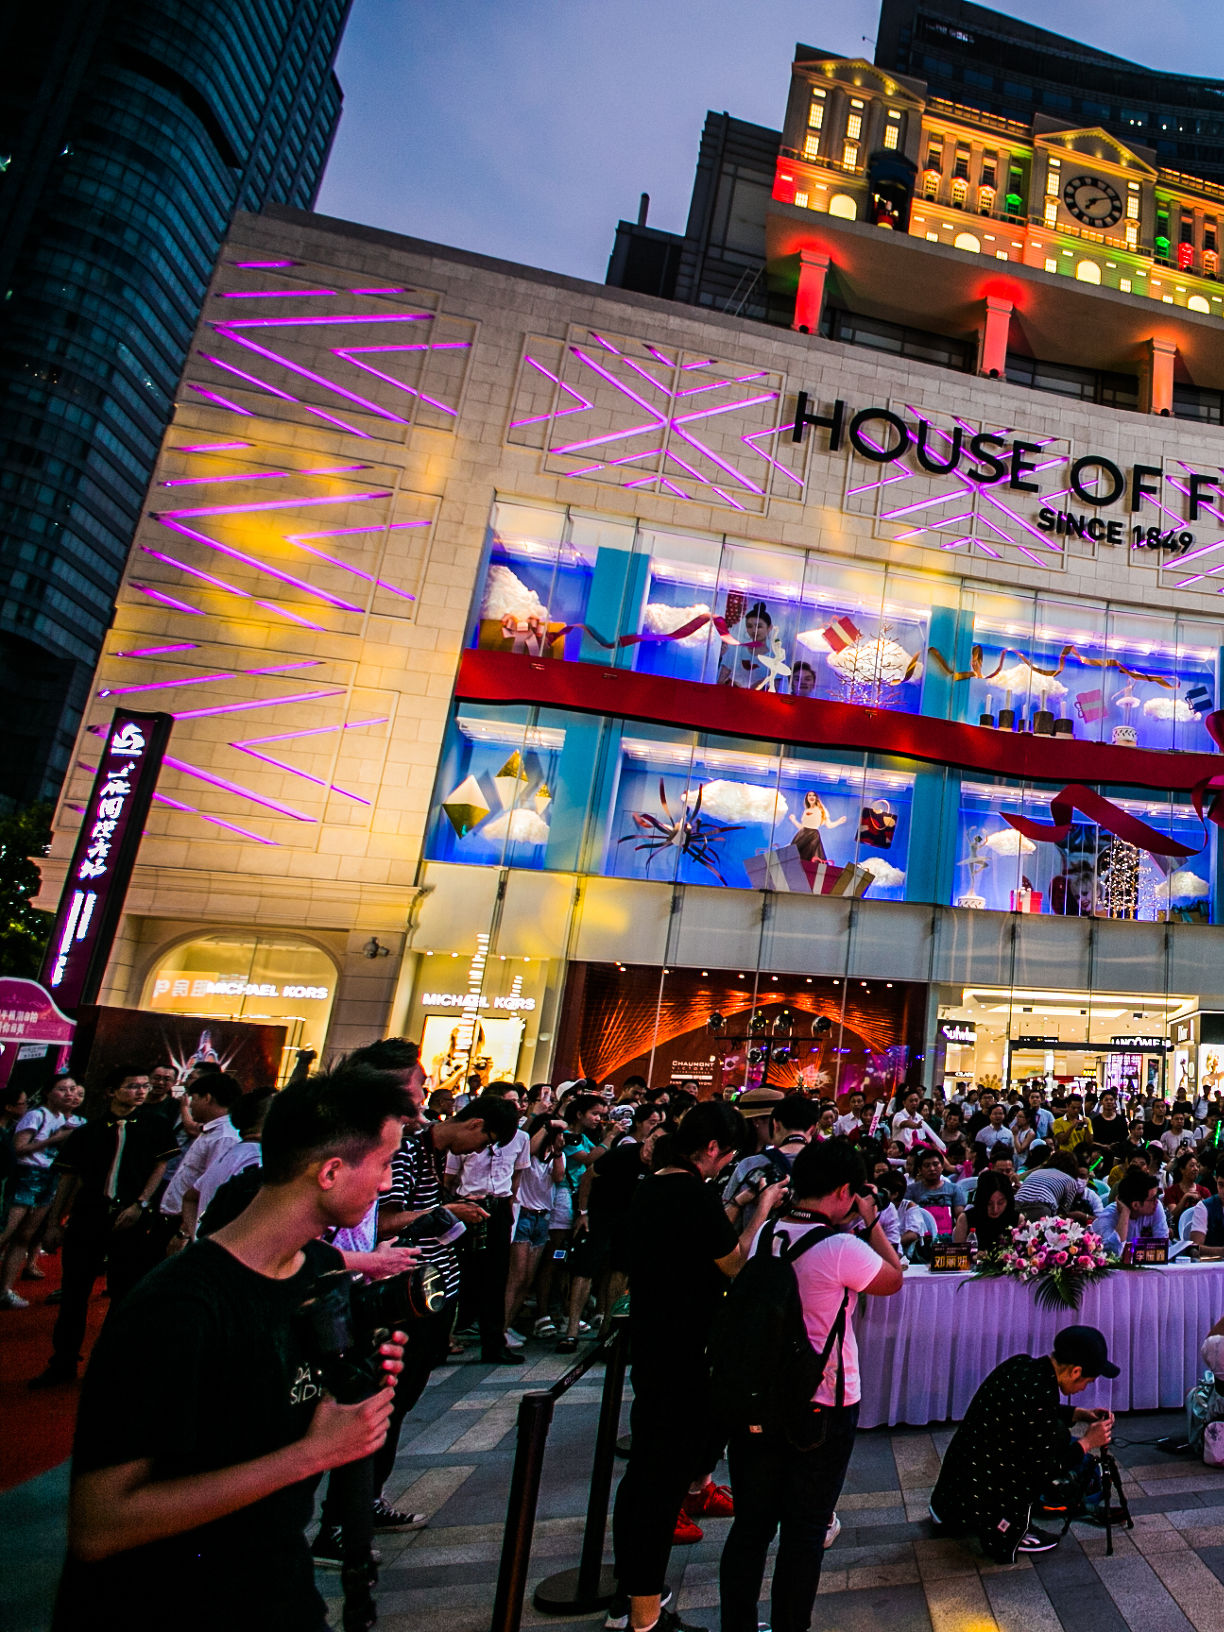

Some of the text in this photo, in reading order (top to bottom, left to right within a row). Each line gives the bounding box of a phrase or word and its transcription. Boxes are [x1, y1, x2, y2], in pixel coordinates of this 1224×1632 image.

[793, 391, 1045, 494] HOUSE
[1070, 454, 1164, 512] OF
[1037, 508, 1195, 556] SINCE 1849
[206, 981, 329, 1001] MICHAEL KORS
[422, 993, 536, 1011] MICHAEL KORS
